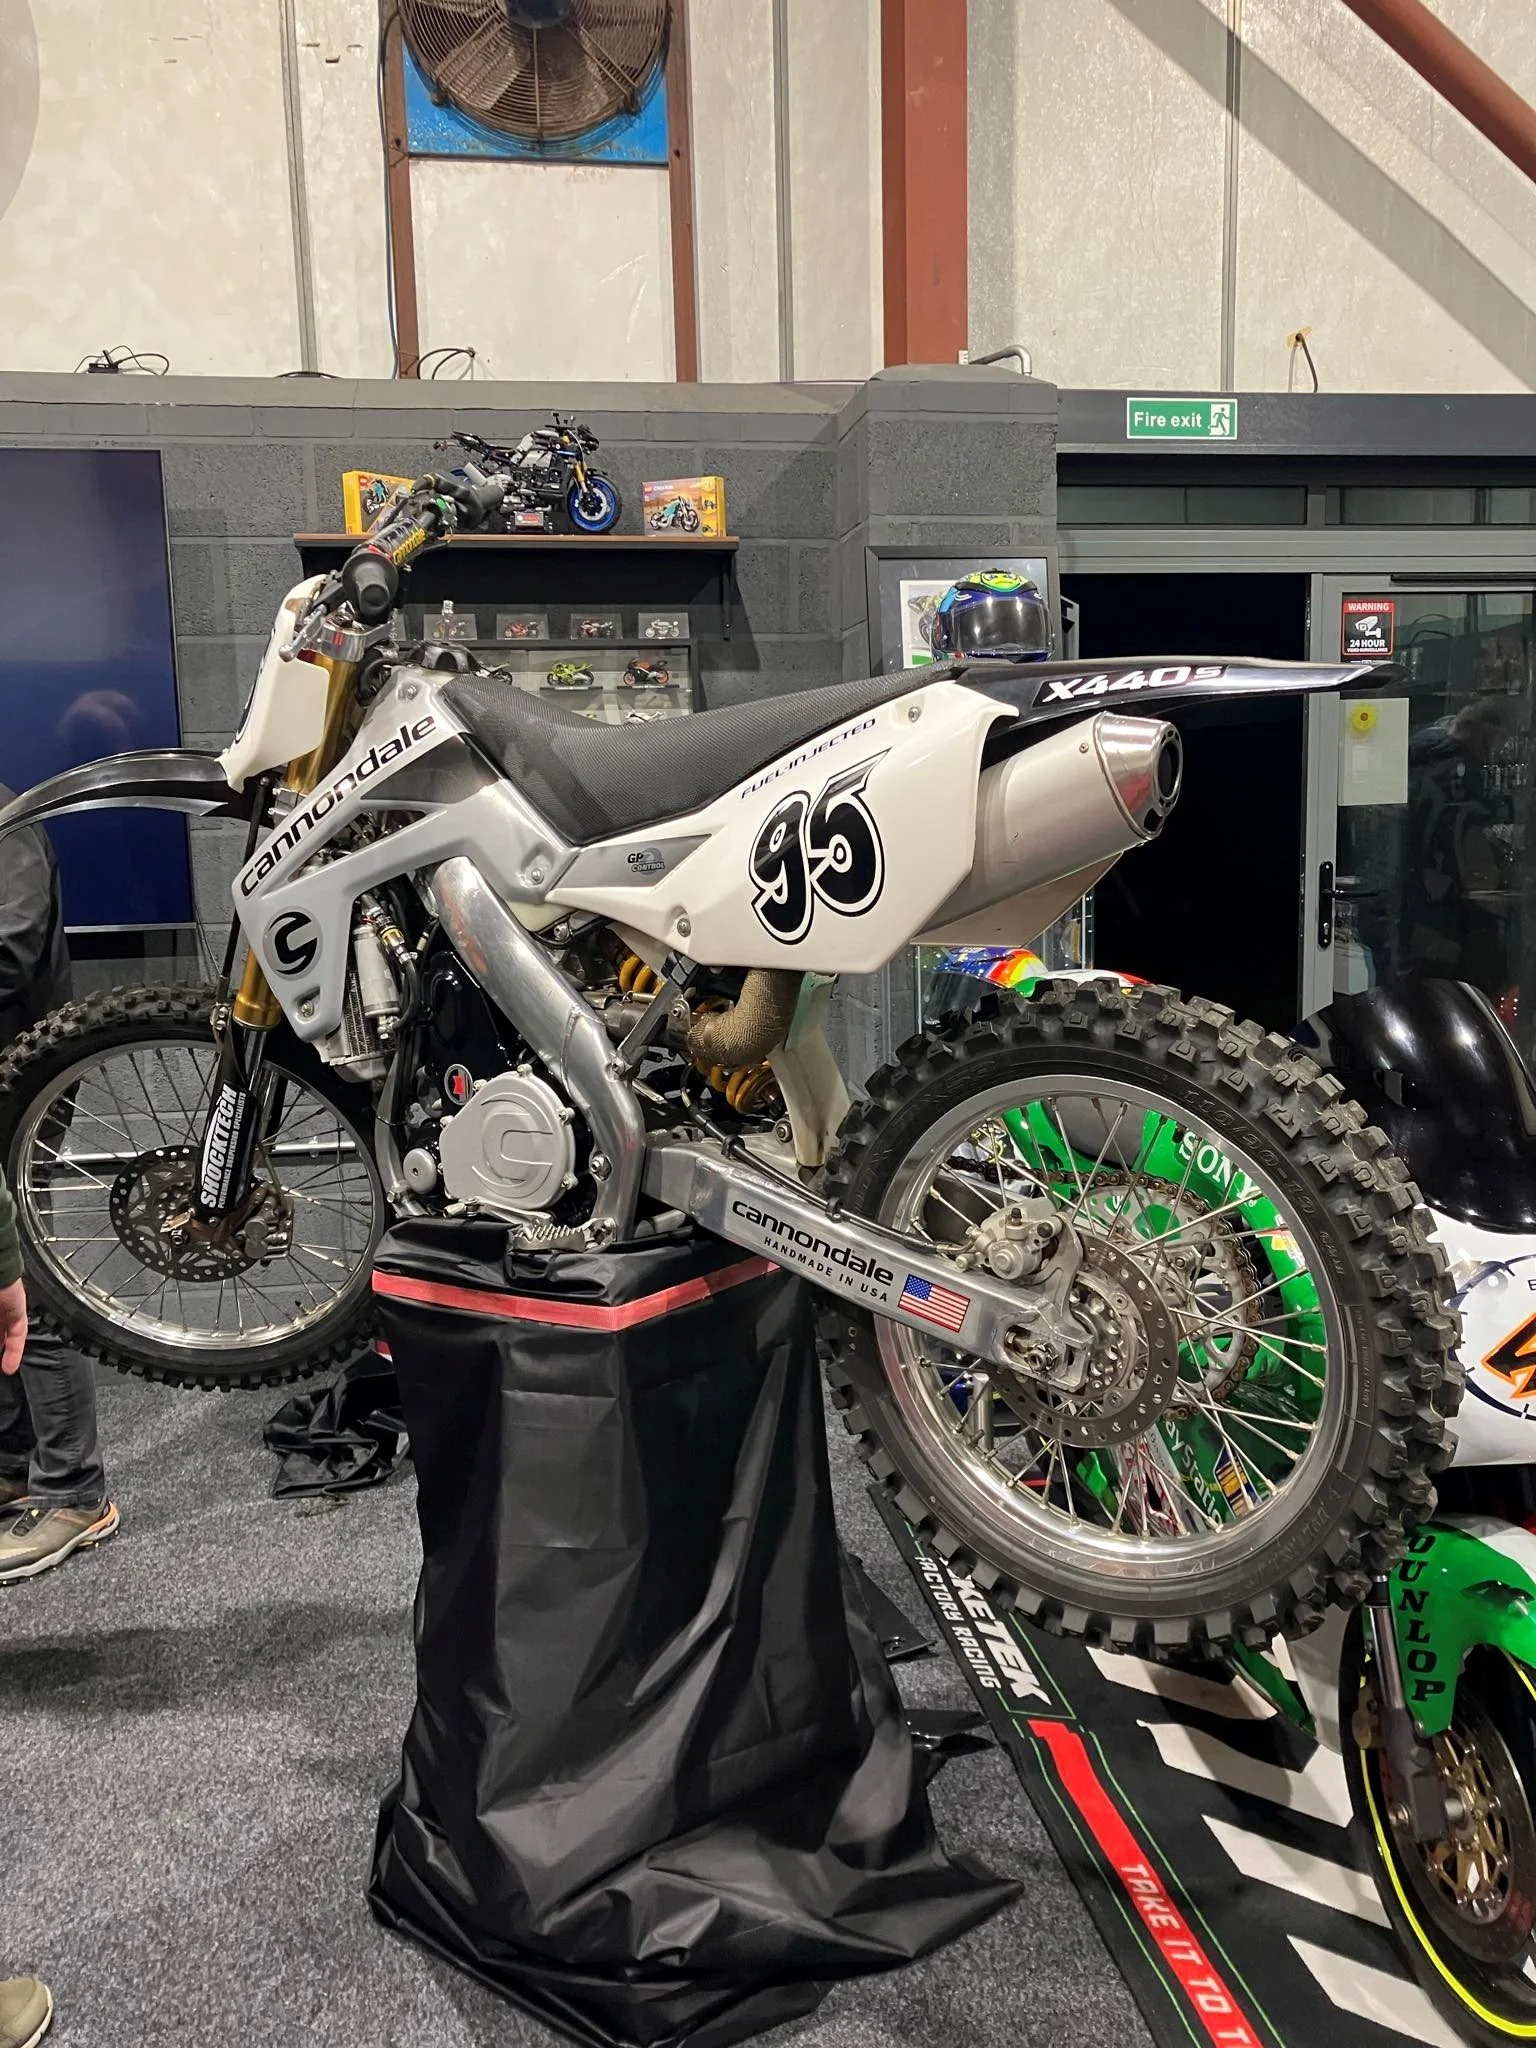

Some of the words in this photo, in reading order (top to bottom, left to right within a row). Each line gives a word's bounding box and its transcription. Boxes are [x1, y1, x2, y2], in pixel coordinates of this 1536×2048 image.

[1134, 411, 1166, 428] Fire
[1170, 412, 1202, 428] exit
[1347, 602, 1390, 611] WARNING
[1349, 639, 1360, 648] 24
[1361, 639, 1386, 648] HOUR
[240, 715, 437, 897] cannondale
[627, 852, 644, 864] GP
[631, 861, 666, 873] CONTROL
[748, 746, 893, 946] 95
[200, 1083, 238, 1208] SHOCKTECH
[1178, 1131, 1264, 1201] SONY
[732, 1199, 894, 1288] cannondale
[764, 1235, 833, 1278] HANDMADE
[839, 1272, 854, 1287] IN
[860, 1284, 888, 1302] USA
[914, 1556, 965, 1622] FACTORY
[951, 1626, 1002, 1689] RACING
[1398, 1534, 1447, 1702] DUNLOP
[1120, 1863, 1181, 1930] TAKE
[1164, 1939, 1204, 1967] IT
[1188, 1976, 1233, 2014] TO
[1216, 2025, 1256, 2048] T
